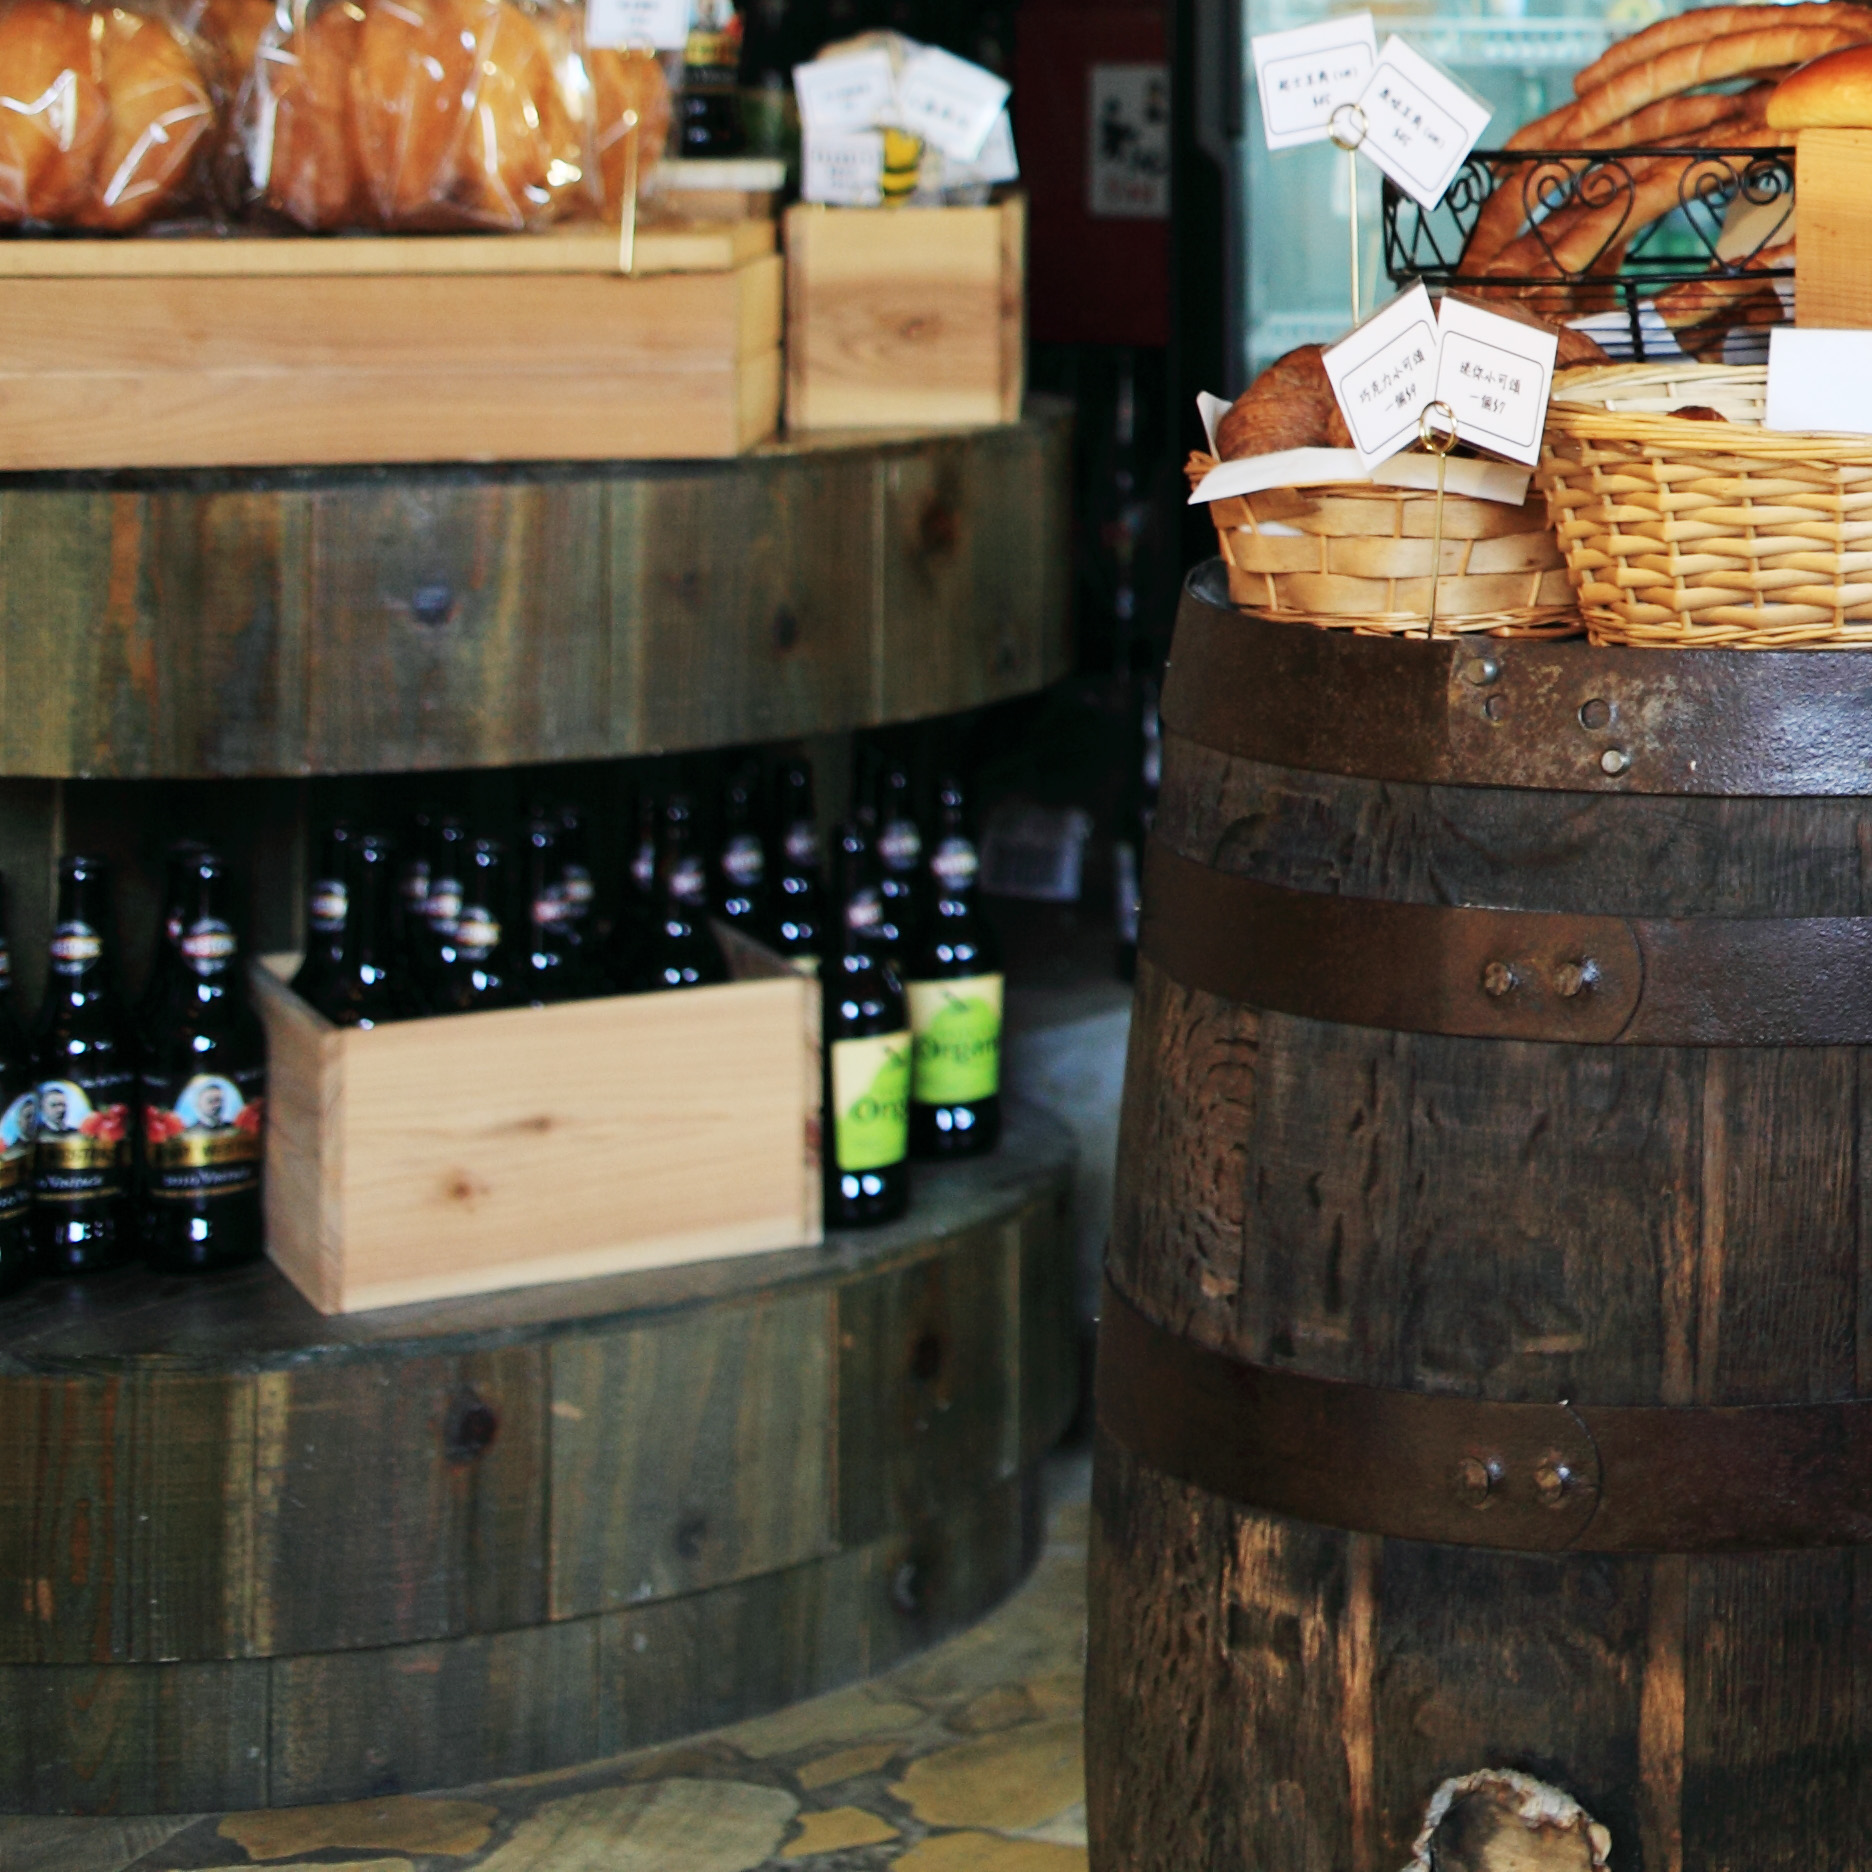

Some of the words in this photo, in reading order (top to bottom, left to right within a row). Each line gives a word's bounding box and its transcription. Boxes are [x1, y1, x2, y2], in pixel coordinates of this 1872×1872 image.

[1458, 359, 1522, 395] 迷你小可頌
